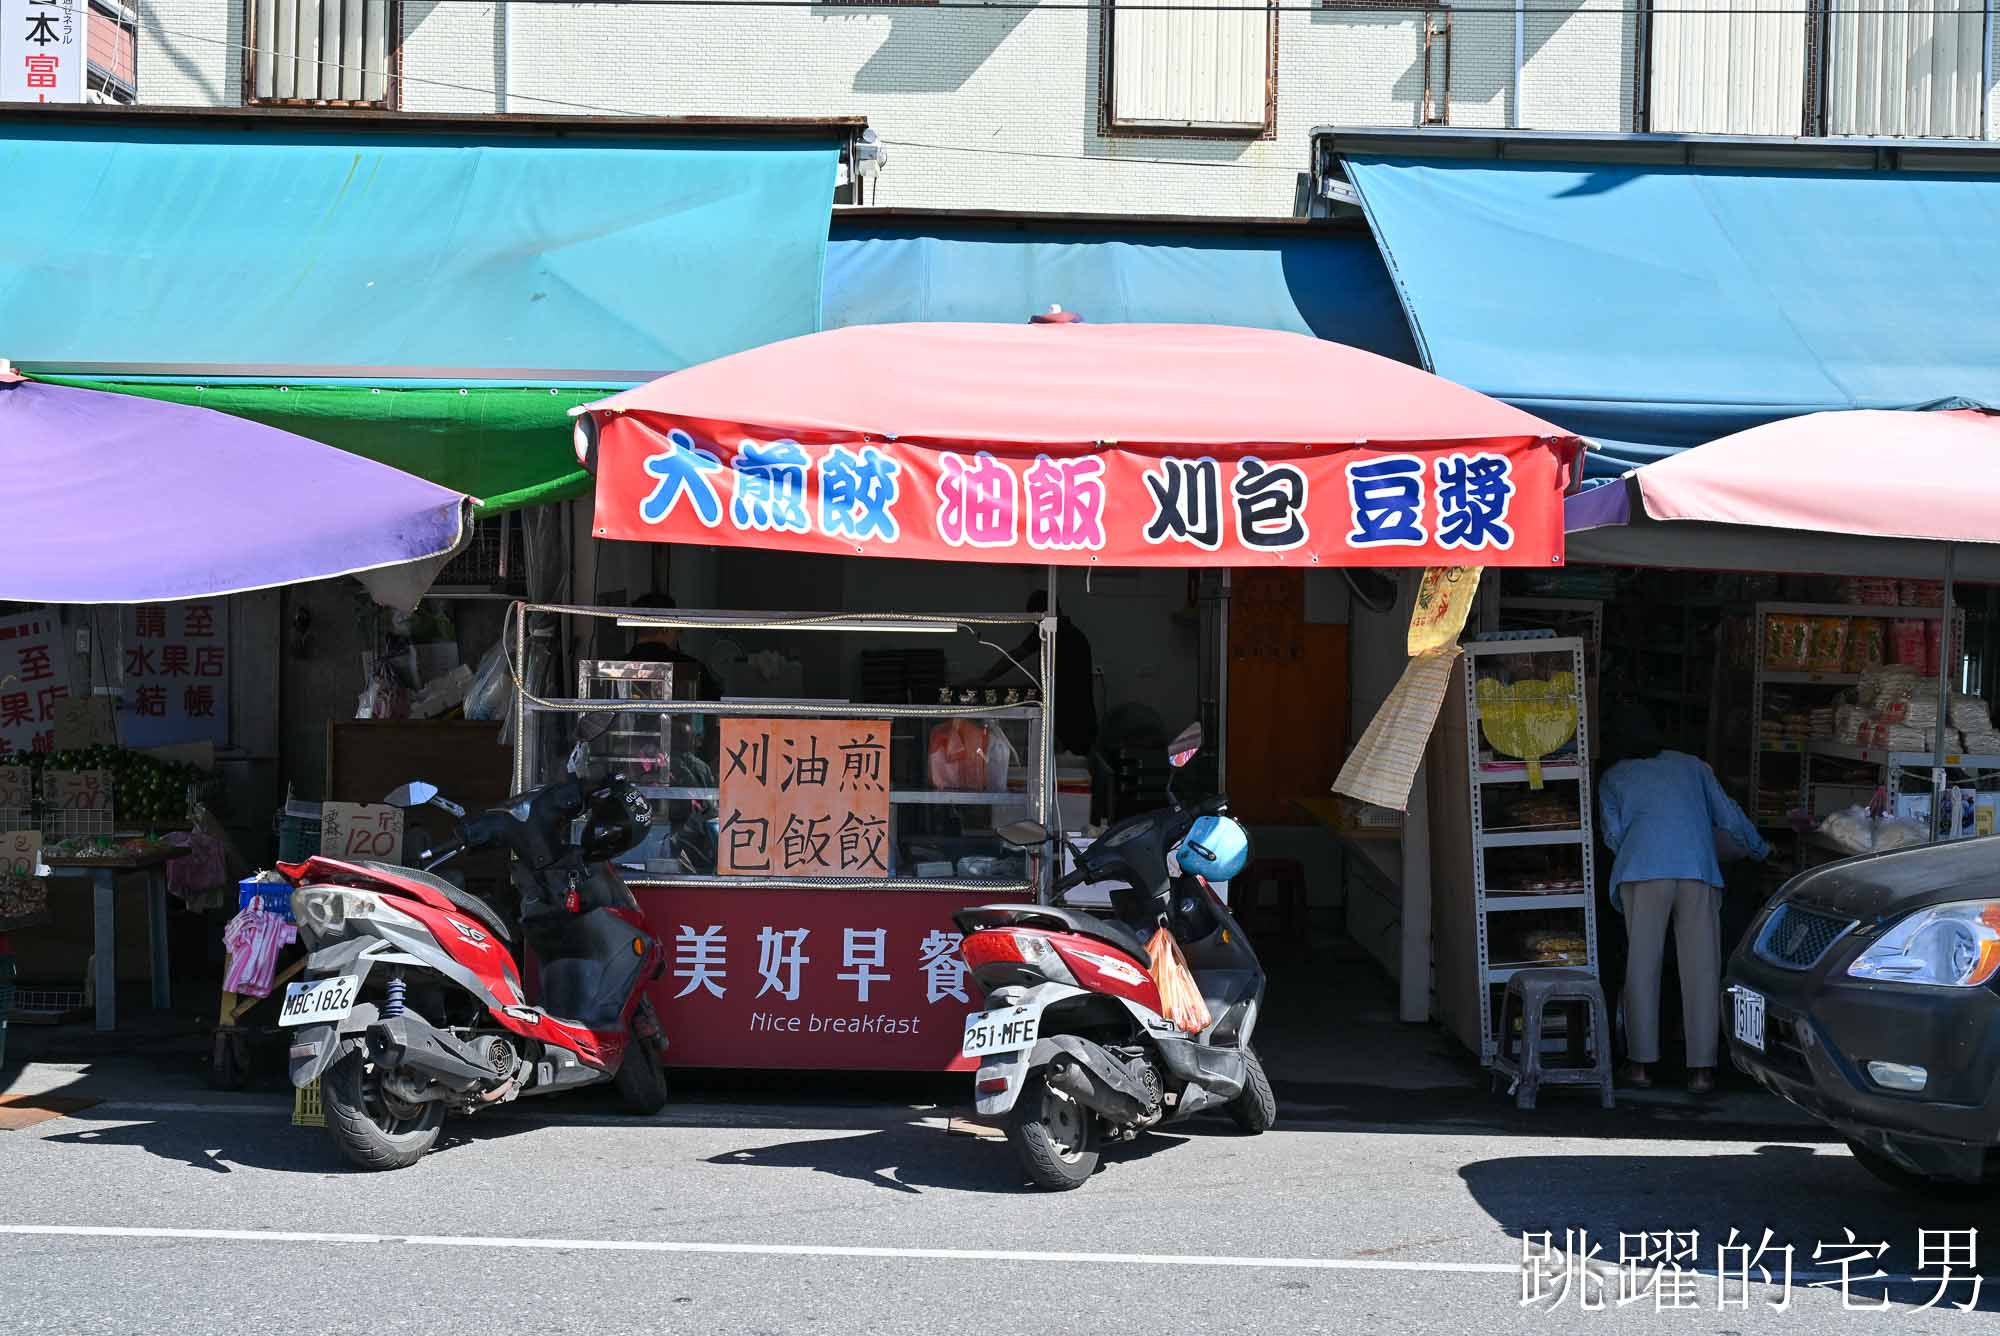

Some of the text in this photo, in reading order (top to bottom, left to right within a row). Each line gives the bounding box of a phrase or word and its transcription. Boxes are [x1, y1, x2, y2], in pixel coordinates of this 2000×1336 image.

[25, 0, 60, 103] 本富
[640, 429, 1515, 552] 大煎餃 油飯 刈包 豆漿
[126, 645, 225, 677] 水果店
[135, 684, 216, 718] 結帳
[344, 828, 395, 857] 120
[720, 733, 771, 871] 刈包
[776, 735, 832, 869] 油飯
[836, 733, 889, 872] 煎餃
[673, 924, 970, 1004] 美好早餐
[750, 1012, 920, 1034] Nice breakfast
